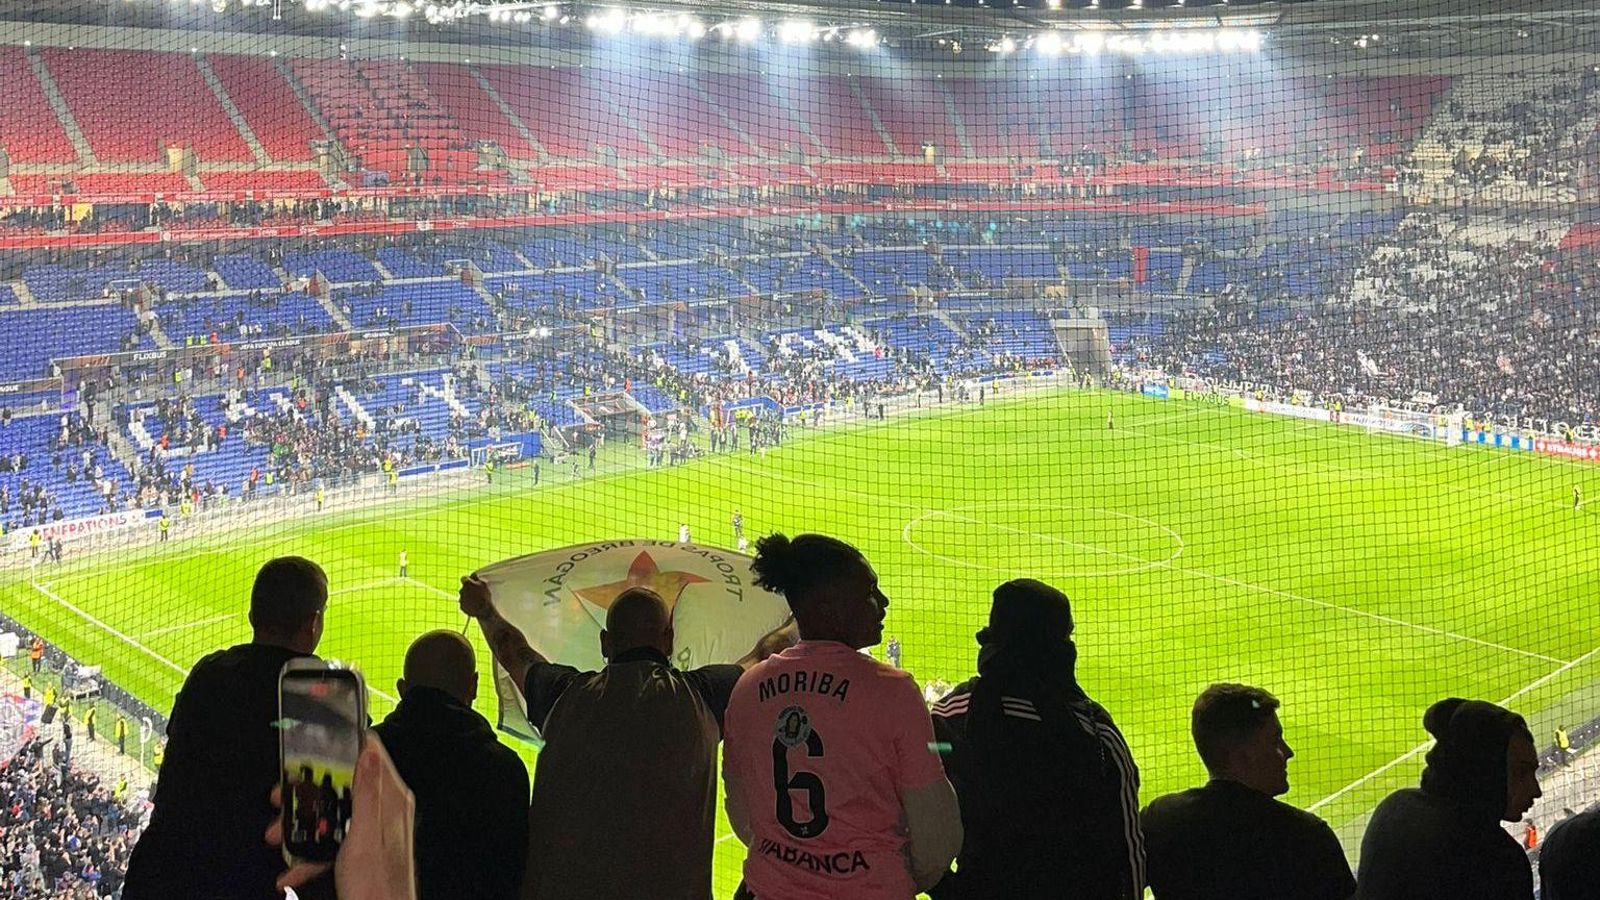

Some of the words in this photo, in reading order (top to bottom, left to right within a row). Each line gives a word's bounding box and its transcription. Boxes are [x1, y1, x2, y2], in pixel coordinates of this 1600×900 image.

[41, 514, 127, 541] ENERATIONS
[758, 671, 850, 702] MORIBA
[772, 727, 829, 838] 6
[759, 839, 871, 874] ABANCA
